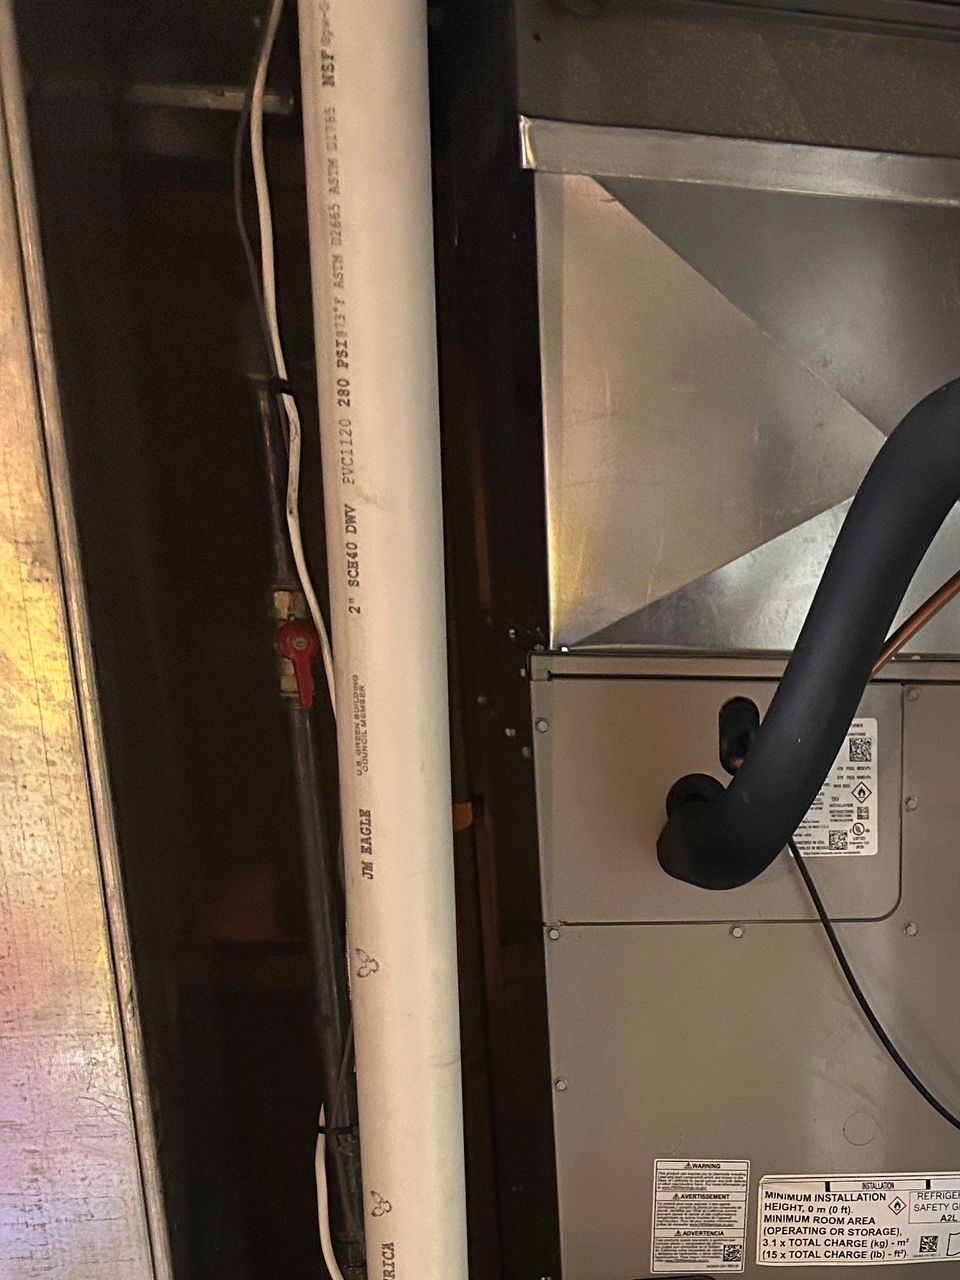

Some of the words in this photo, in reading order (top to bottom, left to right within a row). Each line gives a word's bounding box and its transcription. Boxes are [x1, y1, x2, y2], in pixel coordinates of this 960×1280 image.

[320, 50, 337, 87] NSF
[327, 158, 341, 195] ASTM
[332, 254, 345, 289] ASTM
[337, 378, 351, 408] 280
[341, 419, 356, 485] PVC1120
[345, 504, 358, 534] DWV
[347, 542, 360, 587] SCH40
[348, 596, 361, 614] 2"
[352, 674, 360, 720] BUILDING
[358, 684, 367, 728] MEMBER
[353, 722, 361, 756] GREEN
[360, 730, 369, 773] COUNCIL
[358, 808, 373, 856] EAGLE
[360, 859, 374, 880] JM
[764, 1203, 805, 1213] HEIGHT,
[829, 1206, 838, 1214] (0
[765, 1191, 811, 1202] MINIMUM
[814, 1193, 886, 1202] INSTALLATION
[763, 1227, 826, 1236] (OPERATING
[764, 1215, 810, 1223] MINIMUM
[813, 1216, 845, 1224] ROOM
[762, 1251, 778, 1260] (15
[824, 1251, 867, 1259] CHARGE
[870, 1251, 885, 1260] (lb)
[824, 1239, 867, 1247] CHARGE
[870, 1240, 888, 1248] (kg)
